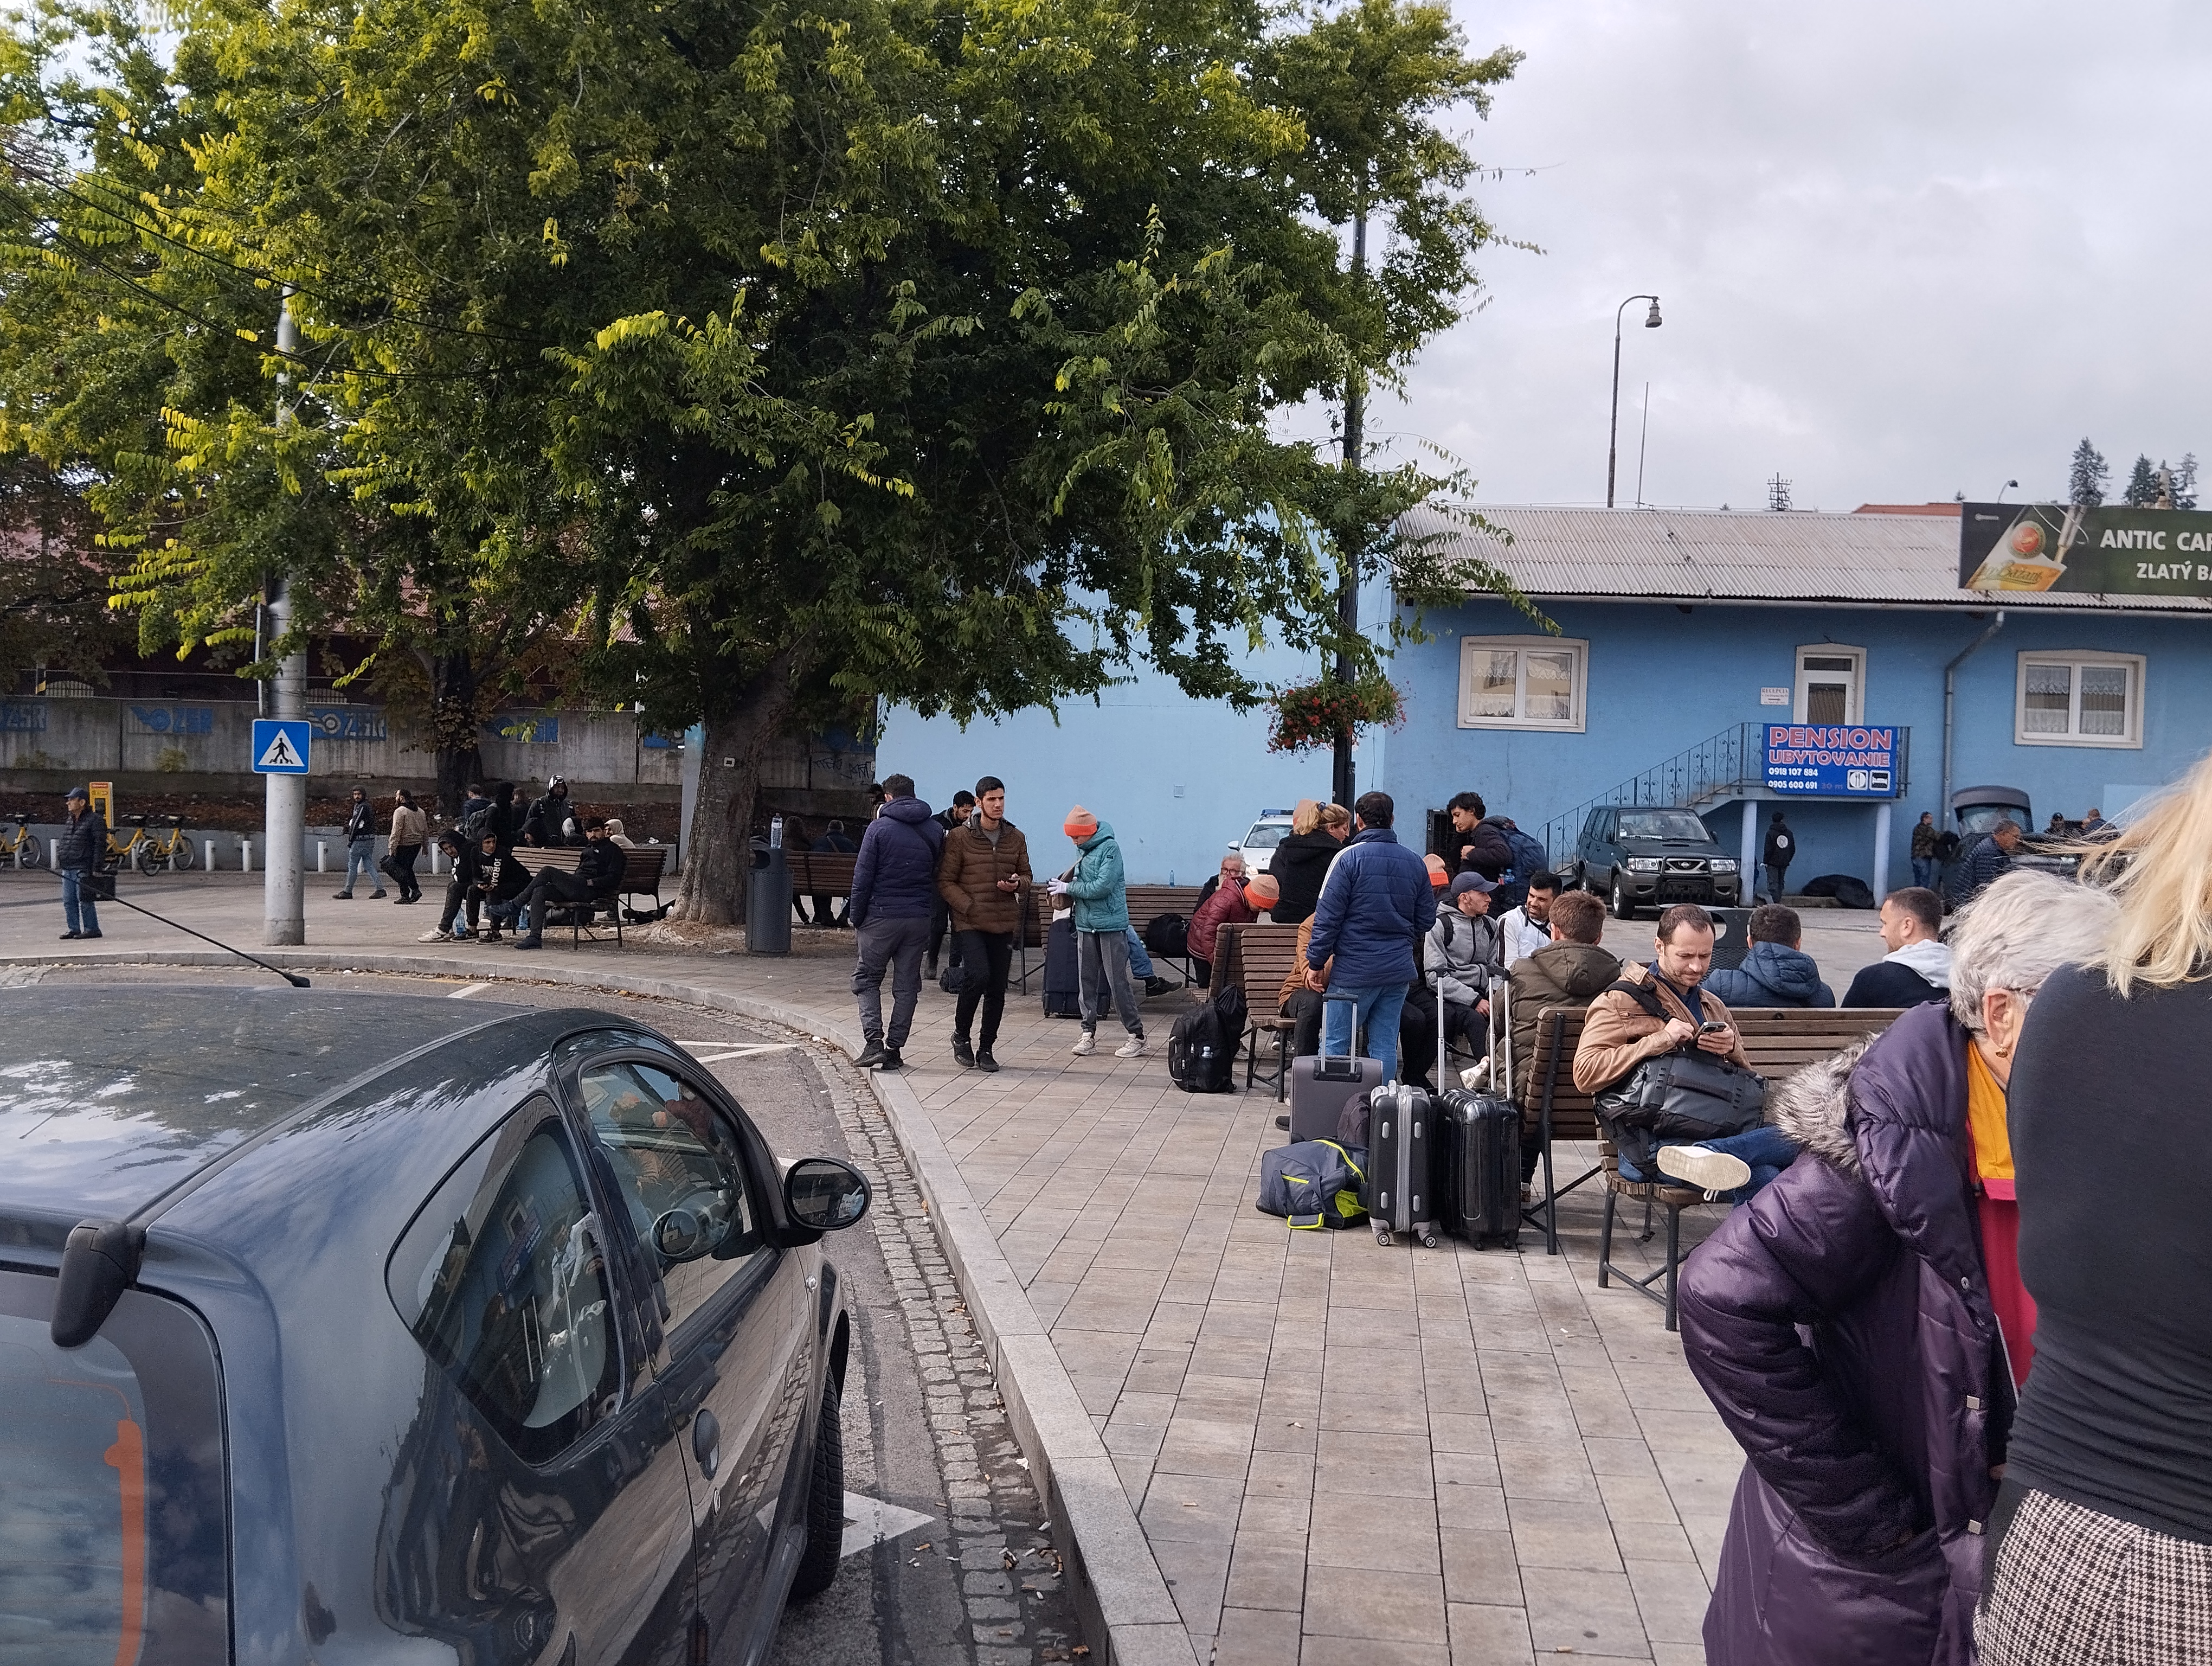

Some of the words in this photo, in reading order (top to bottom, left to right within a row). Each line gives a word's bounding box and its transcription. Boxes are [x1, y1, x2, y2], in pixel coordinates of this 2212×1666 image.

[2100, 529, 2166, 550] ANTIC
[2136, 560, 2192, 580] ZLATÝ
[2197, 565, 2212, 581] B
[1769, 726, 1892, 750] PENSION
[1769, 749, 1891, 767] UBYTOVANIE
[1788, 767, 1802, 776] 107
[1803, 768, 1818, 777] 884
[1767, 780, 1787, 789] 0905
[1788, 780, 1804, 789] 600
[1805, 781, 1817, 790] 691
